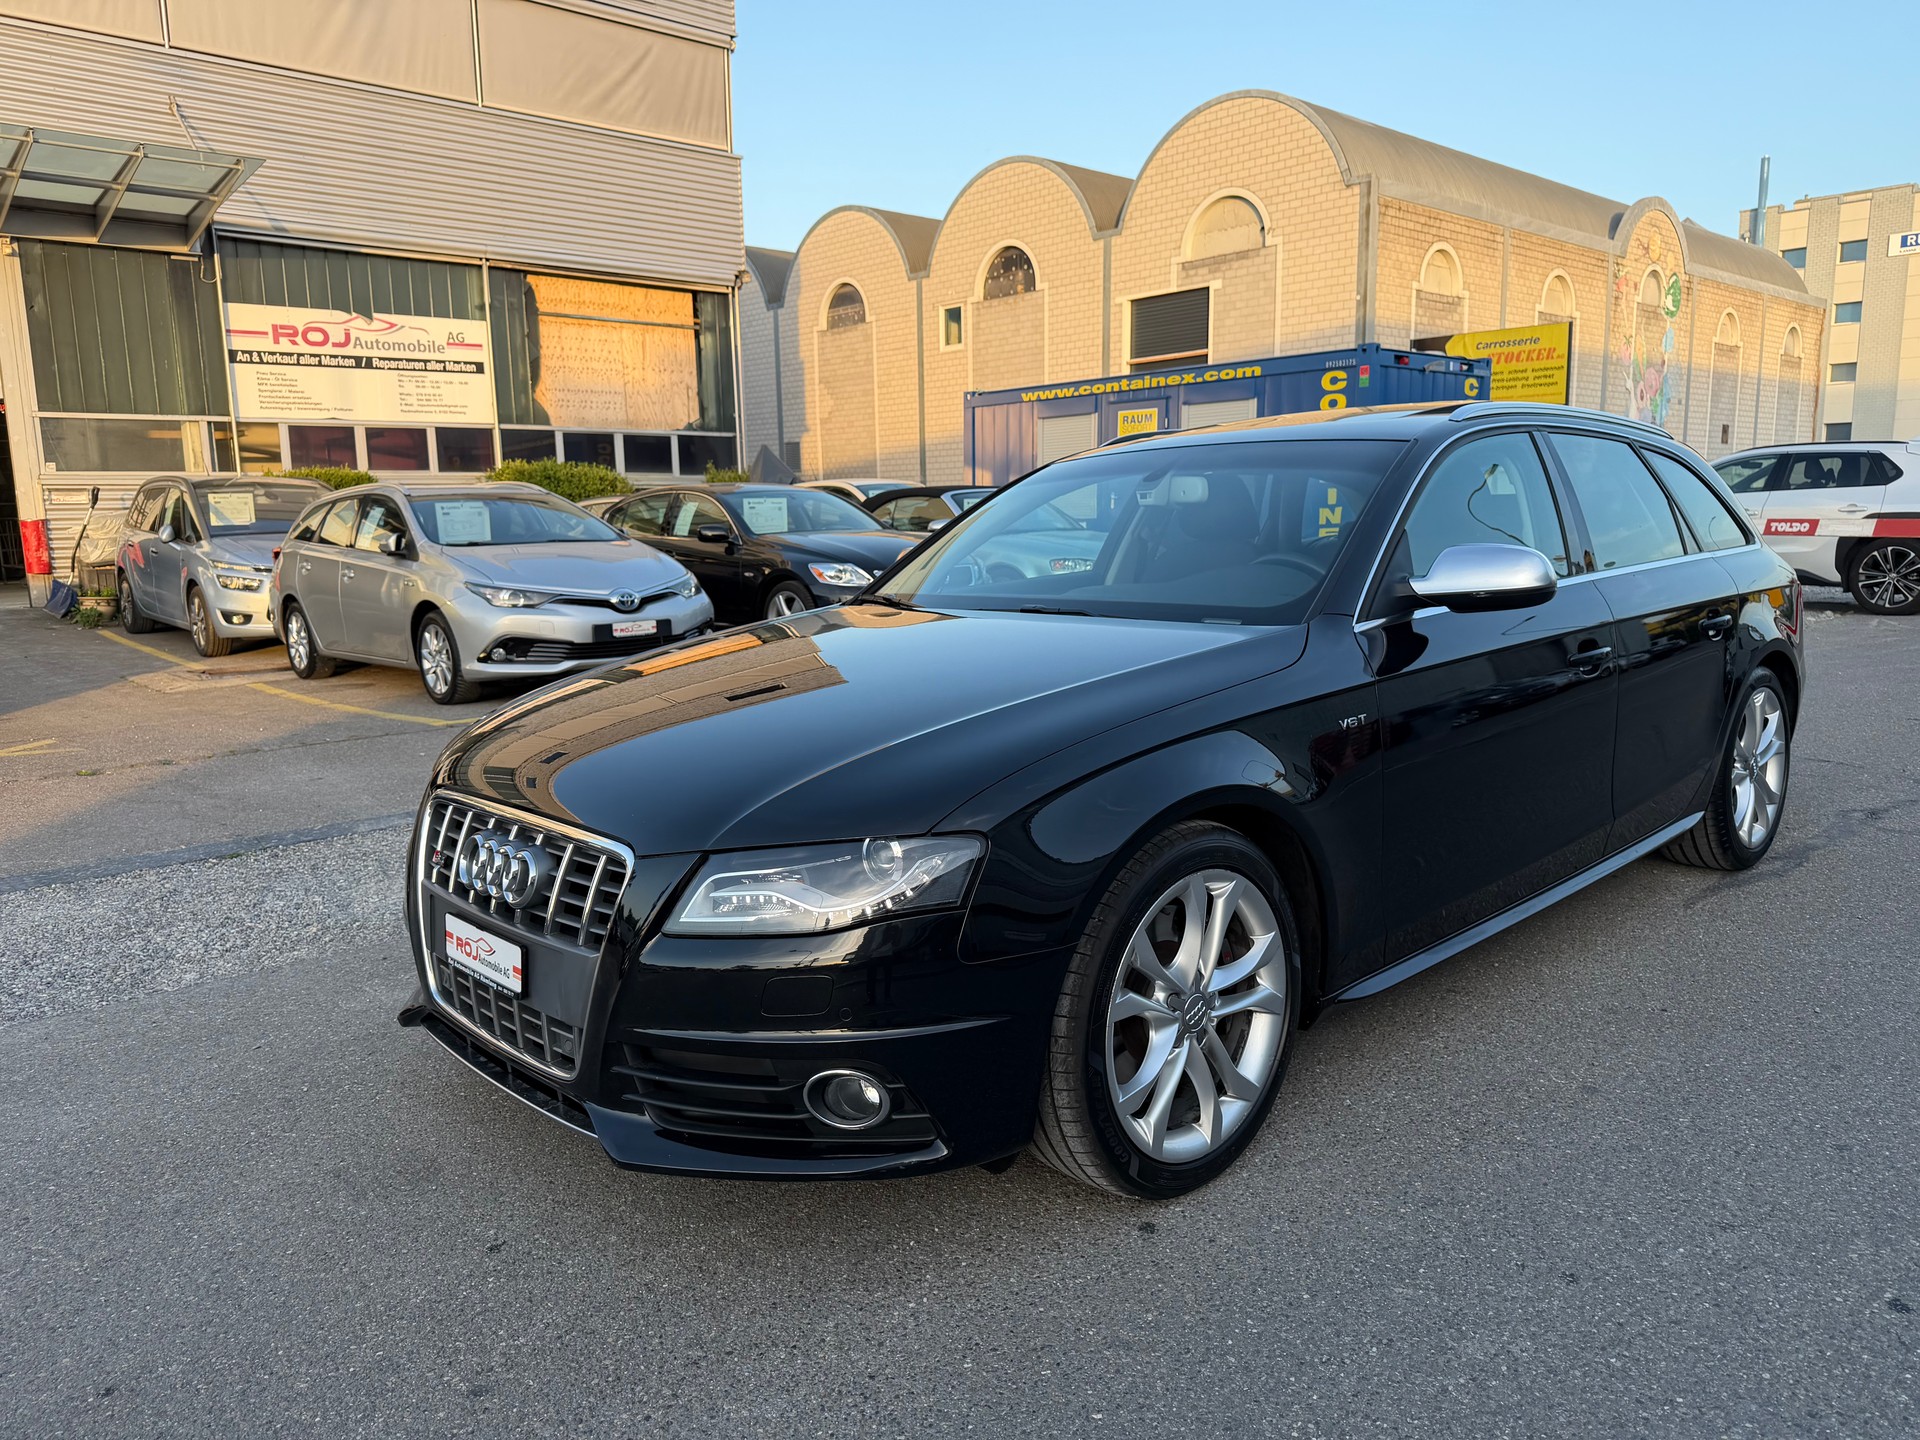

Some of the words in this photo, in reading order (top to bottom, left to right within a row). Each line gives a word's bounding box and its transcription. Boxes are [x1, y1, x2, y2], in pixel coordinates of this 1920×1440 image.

[271, 323, 351, 348] ROJ
[353, 336, 446, 354] Automobile
[447, 331, 466, 344] AG
[236, 351, 250, 362] An
[252, 352, 260, 362] &
[261, 352, 298, 364] Verkauf
[299, 353, 320, 365] aller
[321, 355, 356, 367] Marken
[372, 357, 425, 370] Reparaturen
[426, 361, 445, 371] aller
[445, 361, 477, 373] Marken
[1487, 347, 1557, 365] TOCKER
[1020, 365, 1262, 402] www.containex.com
[1122, 414, 1153, 425] RAUM
[1770, 522, 1811, 533] TOLDO
[455, 935, 479, 961] ROJ
[478, 954, 503, 976] Automobile
[503, 966, 510, 979] AG
